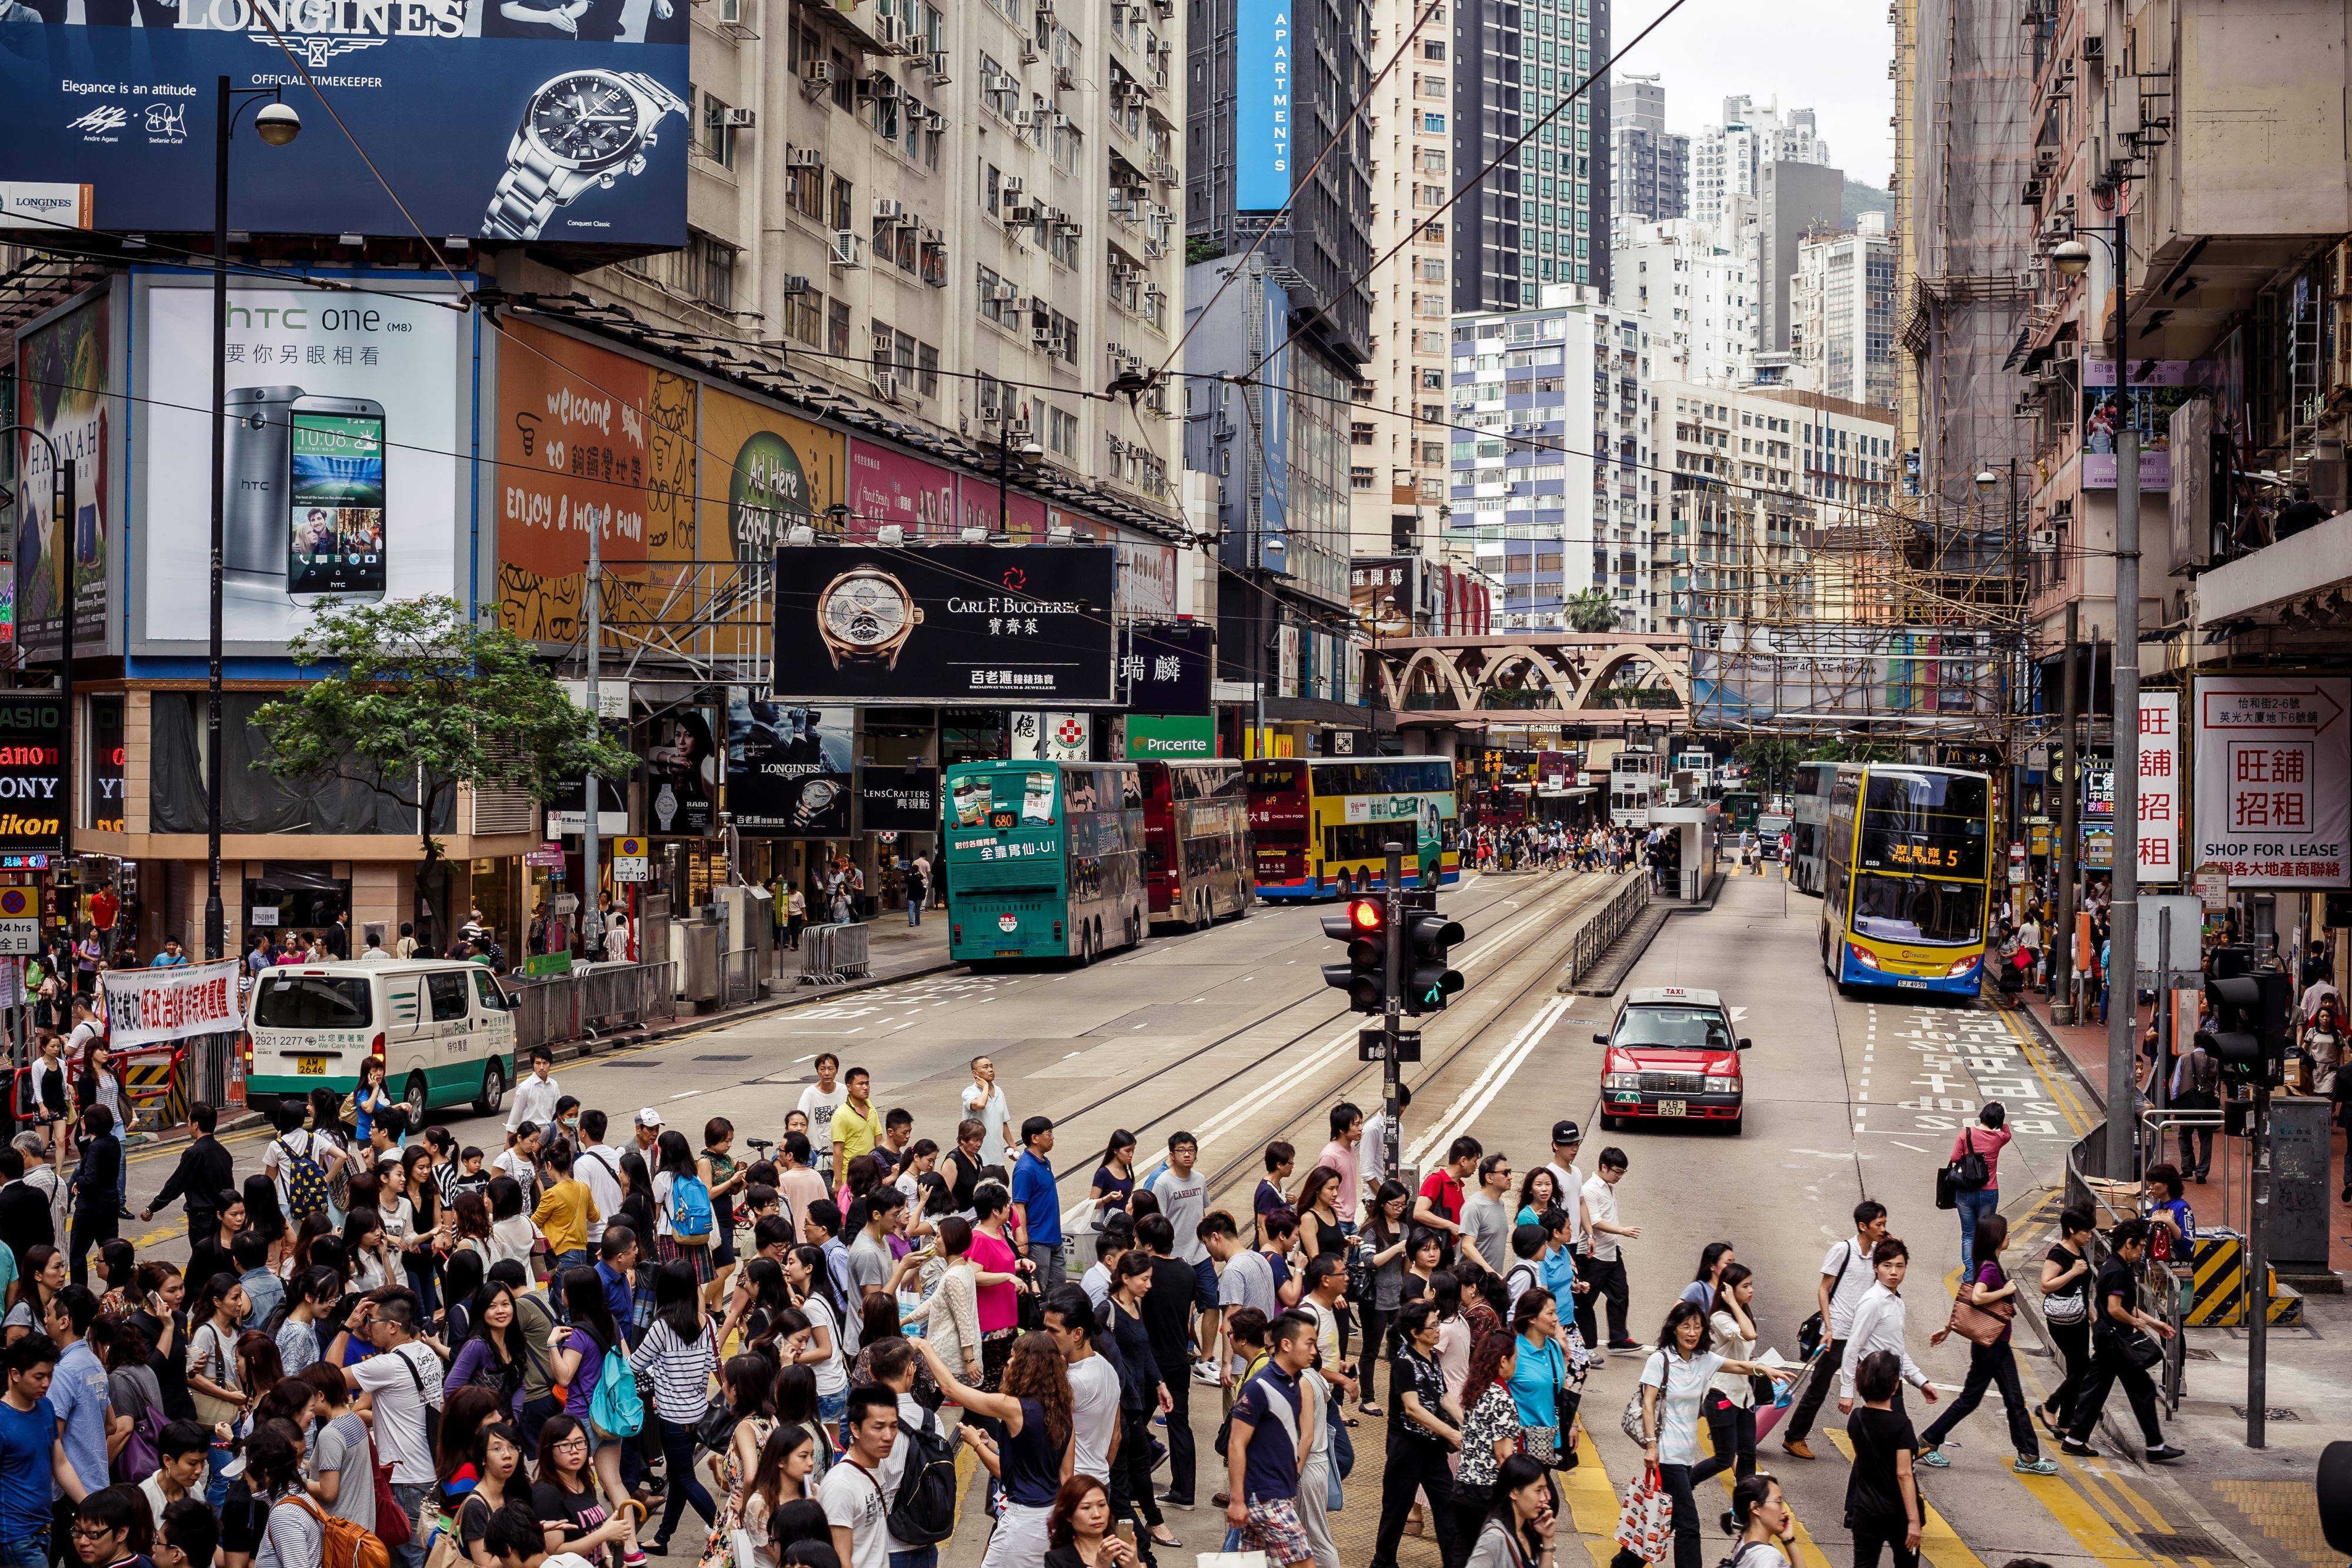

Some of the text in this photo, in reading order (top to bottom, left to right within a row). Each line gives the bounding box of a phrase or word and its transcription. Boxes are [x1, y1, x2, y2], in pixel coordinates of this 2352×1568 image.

[173, 0, 465, 38] LONGINES
[62, 80, 197, 96] Elegance is an attitude
[252, 74, 382, 88] OFFICIAL TIMEKEEPER
[1274, 13, 1288, 172] APARTMENTS
[16, 198, 72, 208] LONGINES
[387, 322, 412, 333] (M8)
[226, 343, 380, 367] 要你另眼相看
[298, 428, 347, 447] 10:08
[31, 420, 97, 476] HANNAH
[749, 452, 797, 499] Ad Here
[863, 486, 876, 503] About
[876, 490, 890, 511] Beauty
[738, 499, 770, 546] 2864
[1351, 569, 1403, 586] 重開幕
[947, 598, 1080, 614] CARL F. BUCHERER
[988, 618, 1039, 636] 寶齊萊
[1120, 653, 1181, 683] 瑞麟
[2238, 697, 2300, 710] 怡和街2-6號
[1147, 738, 1207, 752] Pricerite
[761, 764, 820, 773] LONGINES
[0, 777, 59, 799] ONY
[1266, 797, 1277, 805] 619
[2236, 791, 2306, 827] 招租
[995, 815, 1012, 827] 680
[980, 840, 1055, 861] 全靠胃仙-U!
[1896, 845, 1940, 858] 摩星嶺
[2206, 844, 2338, 857] SHOP FOR LEASE
[1892, 854, 1940, 865] Felix Villas
[1947, 850, 1957, 867] 5
[636, 872, 646, 880] 12
[14, 923, 32, 932] hrs
[0, 937, 28, 950] 全日
[441, 1022, 467, 1040] SpeedPost
[256, 1036, 303, 1046] 2921 2277
[299, 1066, 326, 1074] 2646
[1666, 1101, 1679, 1109] KB
[1173, 1187, 1202, 1201] CARHARTT
[417, 1353, 435, 1366] DEAD
